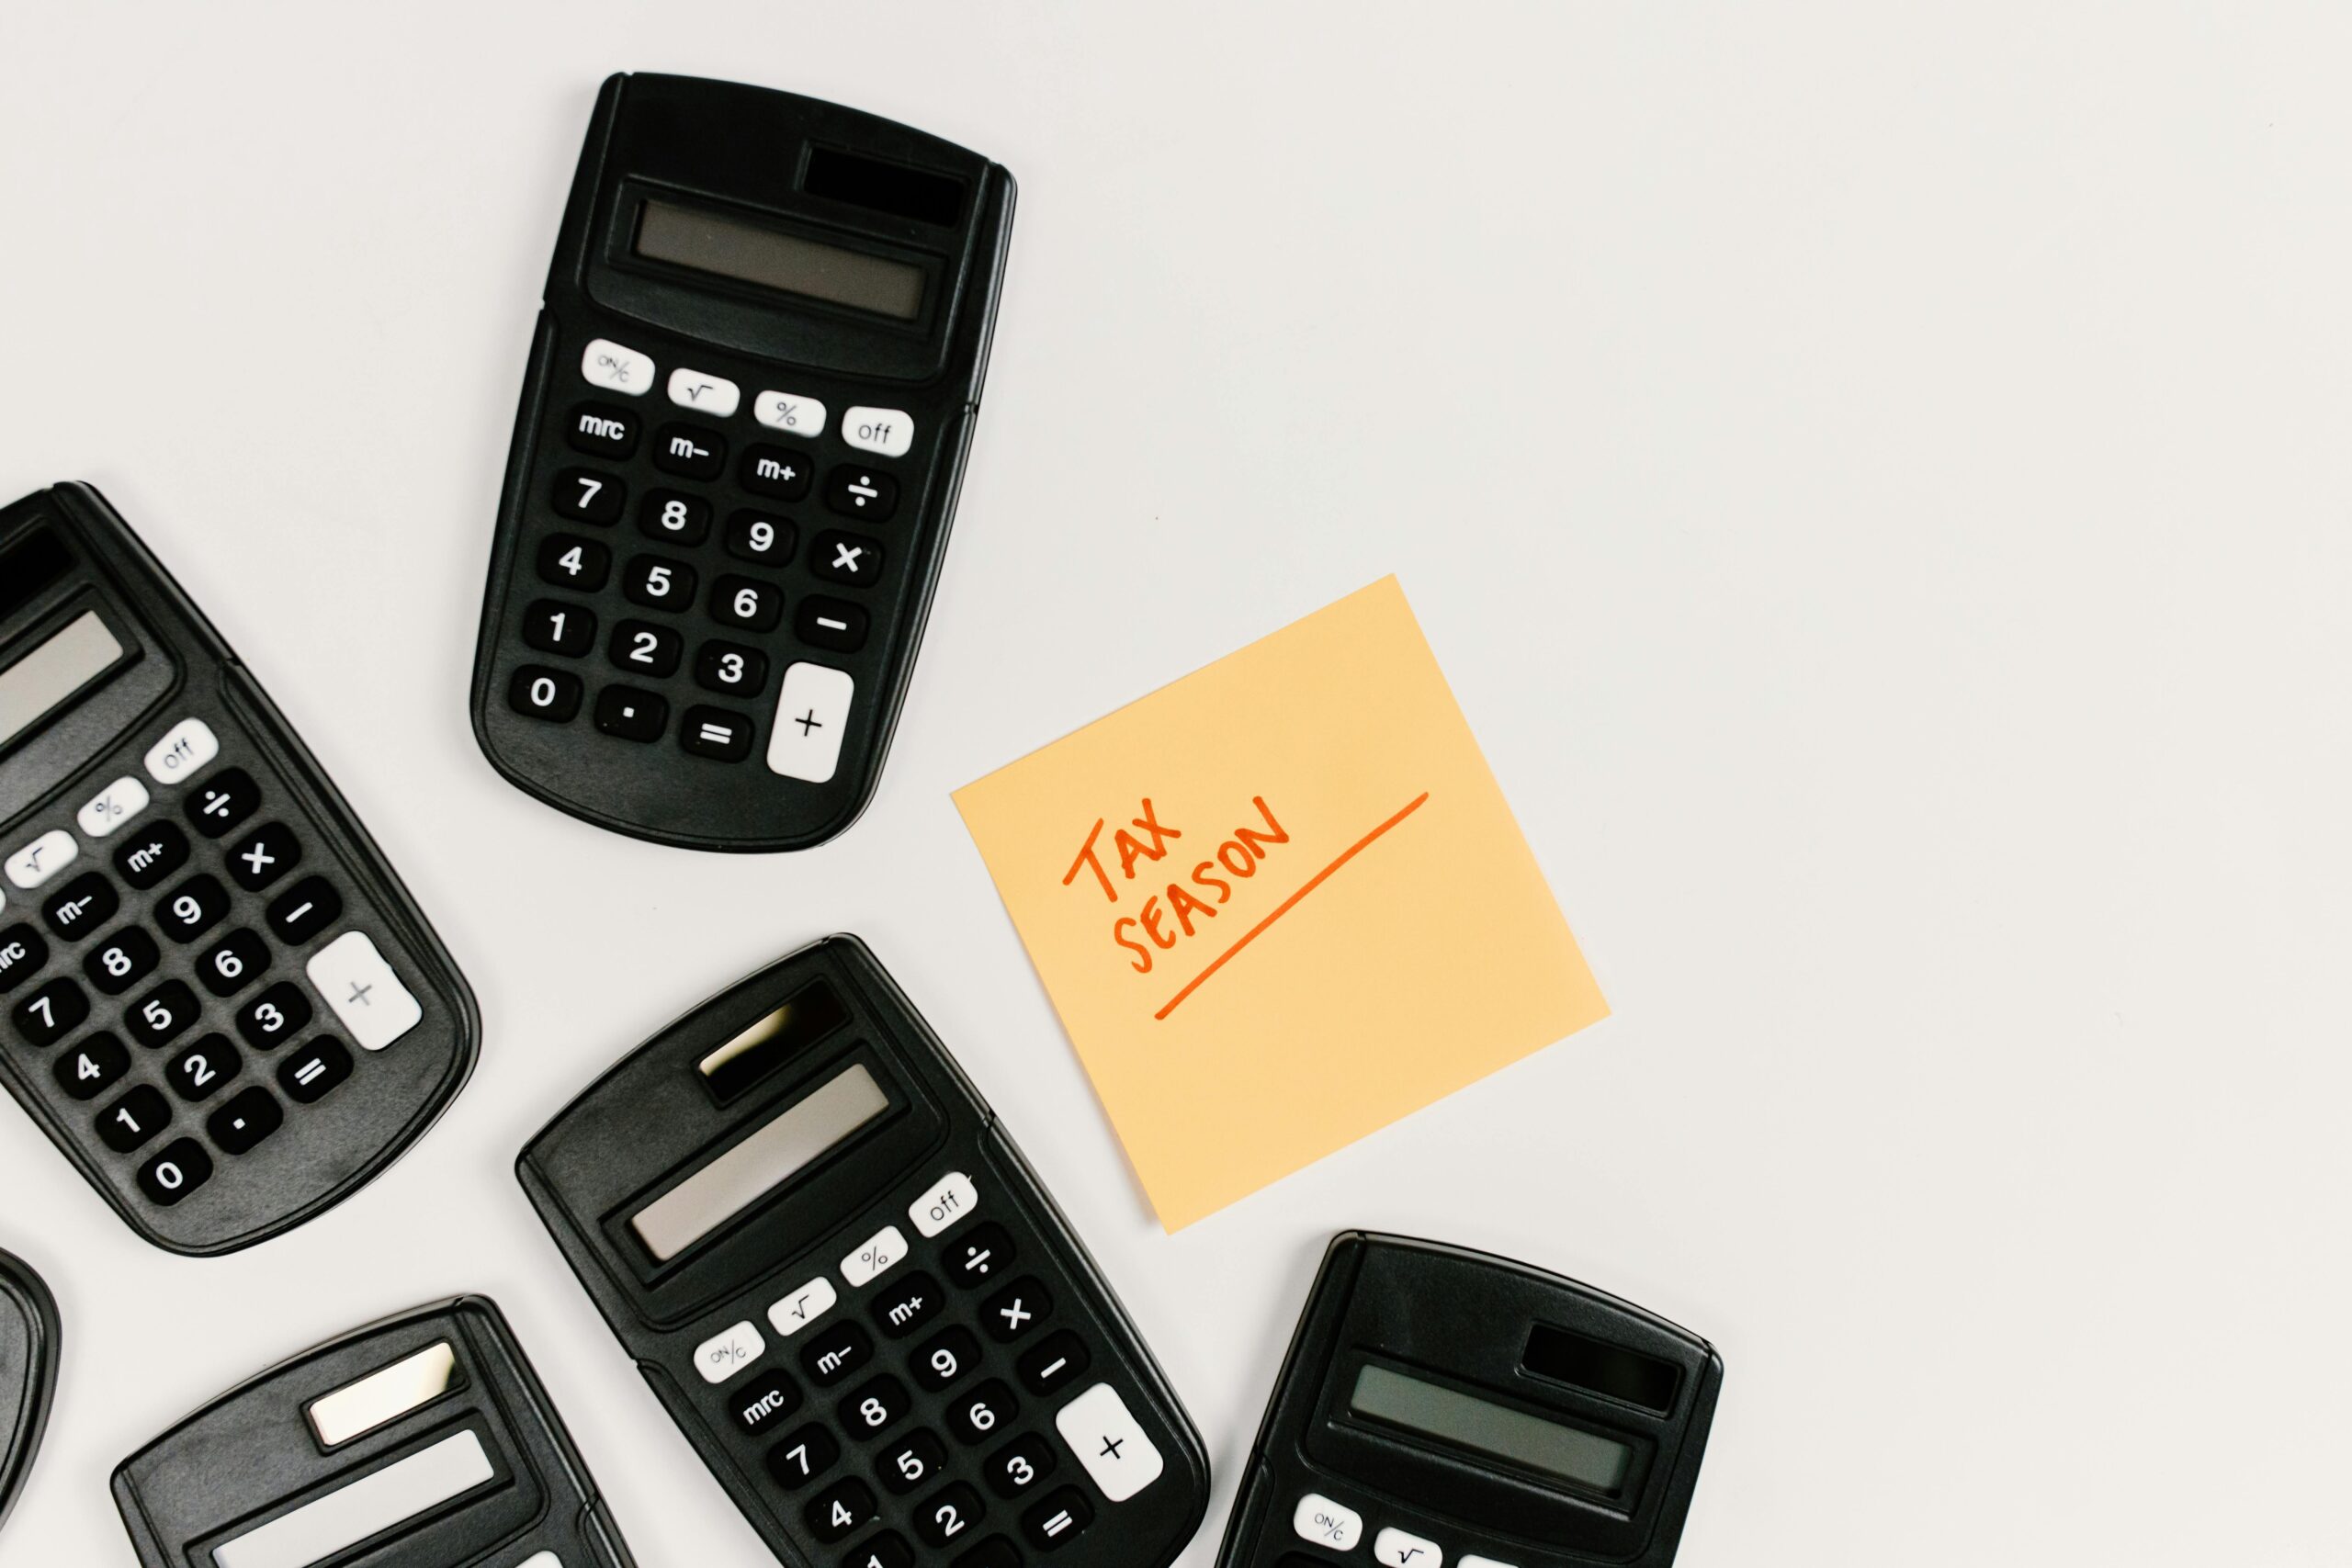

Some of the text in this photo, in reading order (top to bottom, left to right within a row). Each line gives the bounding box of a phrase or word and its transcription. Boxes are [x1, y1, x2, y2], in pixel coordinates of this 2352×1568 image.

[579, 415, 625, 441] mrc
[776, 401, 797, 426] %
[858, 423, 892, 445] off
[757, 458, 796, 480] m+
[578, 478, 603, 509] 7
[661, 500, 687, 531] 8
[749, 522, 775, 552] 9
[559, 547, 582, 576] 4
[646, 566, 672, 597] 5
[733, 588, 758, 618] 6
[550, 613, 566, 642] 1
[629, 632, 658, 663] 2
[718, 653, 744, 683] 3
[530, 677, 556, 706] 0
[794, 708, 823, 738] +
[164, 738, 194, 770] off
[128, 842, 164, 873] m+
[1062, 797, 1182, 904] TAX
[1114, 795, 1291, 974] SEASON
[173, 896, 202, 924] 9
[102, 947, 132, 976] 8
[215, 950, 243, 978] 6
[348, 982, 373, 1007] +
[28, 996, 55, 1028] 7
[142, 999, 173, 1031] 5
[254, 1003, 284, 1032] 3
[77, 1053, 101, 1080] 4
[184, 1055, 216, 1087] 2
[116, 1108, 141, 1133] 1
[155, 1161, 184, 1190] 0
[930, 1190, 960, 1222] off
[861, 1246, 888, 1270] %
[888, 1295, 923, 1325] m+
[931, 1348, 957, 1378] 9
[742, 1390, 784, 1425] mrc
[860, 1397, 888, 1427] 8
[969, 1403, 995, 1430] 6
[786, 1443, 809, 1475] 7
[1100, 1435, 1124, 1460] +
[897, 1450, 924, 1480] 5
[1007, 1456, 1035, 1485] 3
[831, 1500, 853, 1528] 4
[935, 1505, 965, 1537] 2
[1314, 1512, 1344, 1541] ON/C
